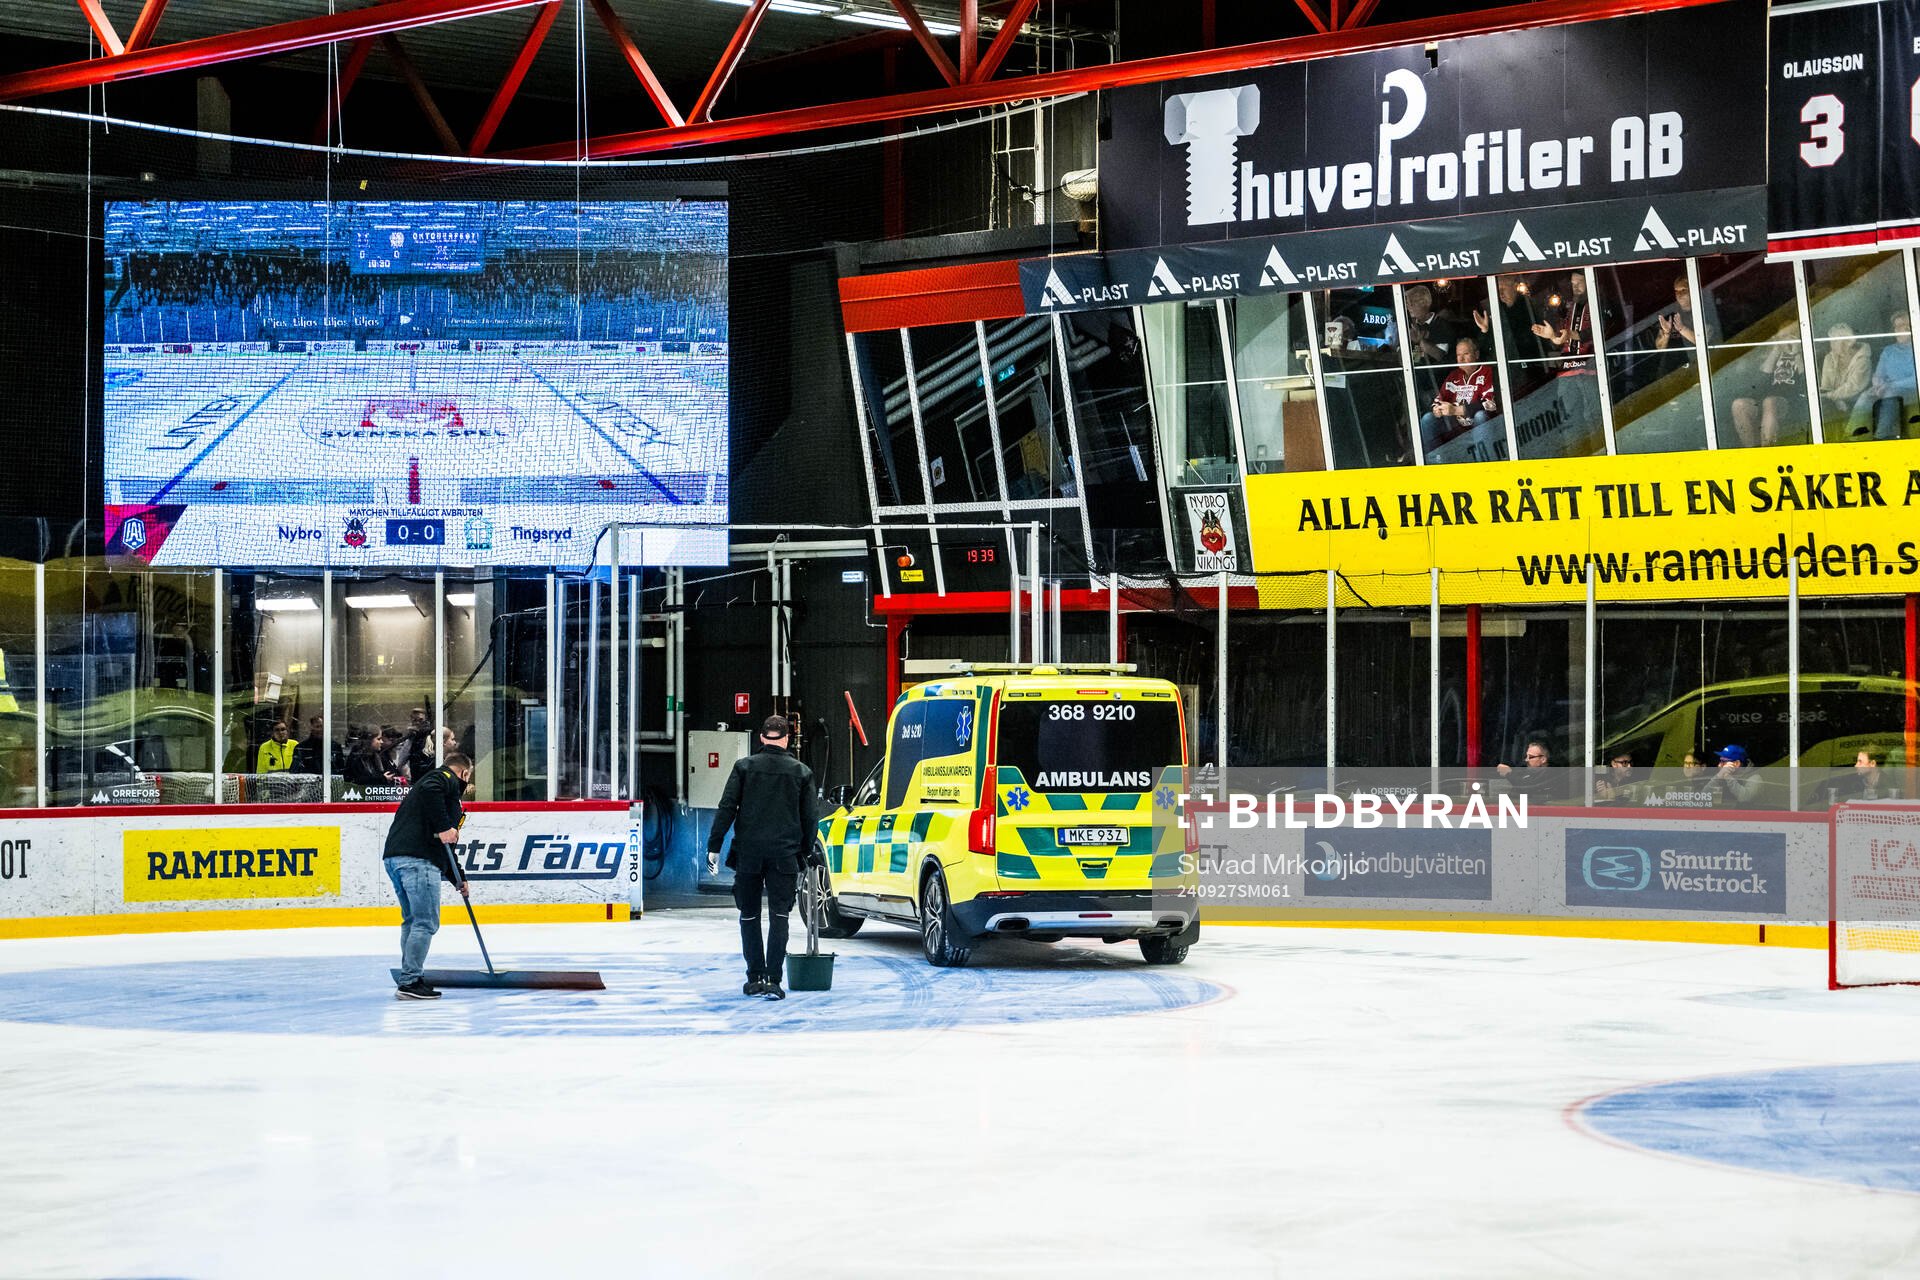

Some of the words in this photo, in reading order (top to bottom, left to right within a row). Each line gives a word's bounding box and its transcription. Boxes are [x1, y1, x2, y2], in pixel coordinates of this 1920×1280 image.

[1783, 53, 1864, 79] OLAUSSON
[1800, 94, 1844, 168] 3
[1610, 111, 1683, 183] AB
[1189, 494, 1226, 509] NYBRO
[1297, 496, 1388, 531] ALLA
[1397, 491, 1479, 528] HAR
[1488, 477, 1582, 523] RÄTT
[1595, 482, 1673, 519] TILL
[1684, 479, 1736, 515] EN
[1748, 464, 1888, 513] SÄKER
[349, 508, 389, 517] MATCHEN
[441, 508, 483, 517] AVBRUTEN
[278, 526, 322, 542] Nybro
[511, 526, 572, 543] Tingsryd
[1196, 556, 1236, 570] VIKINGS
[1048, 704, 1085, 721] 368
[1093, 704, 1136, 721] 9210
[1035, 771, 1150, 787] AMBULANS
[112, 789, 160, 798] ORREFORS
[365, 787, 413, 795] ORREFOR
[1665, 791, 1712, 801] ORREFORS
[1069, 829, 1093, 842] MKE
[1098, 829, 1122, 841] 93Z
[147, 848, 318, 881] RAMIRENT
[517, 834, 627, 880] Färg
[630, 829, 639, 883] ICEPRO
[1660, 849, 1753, 871] Smurfit
[1659, 871, 1767, 894] Westrock
